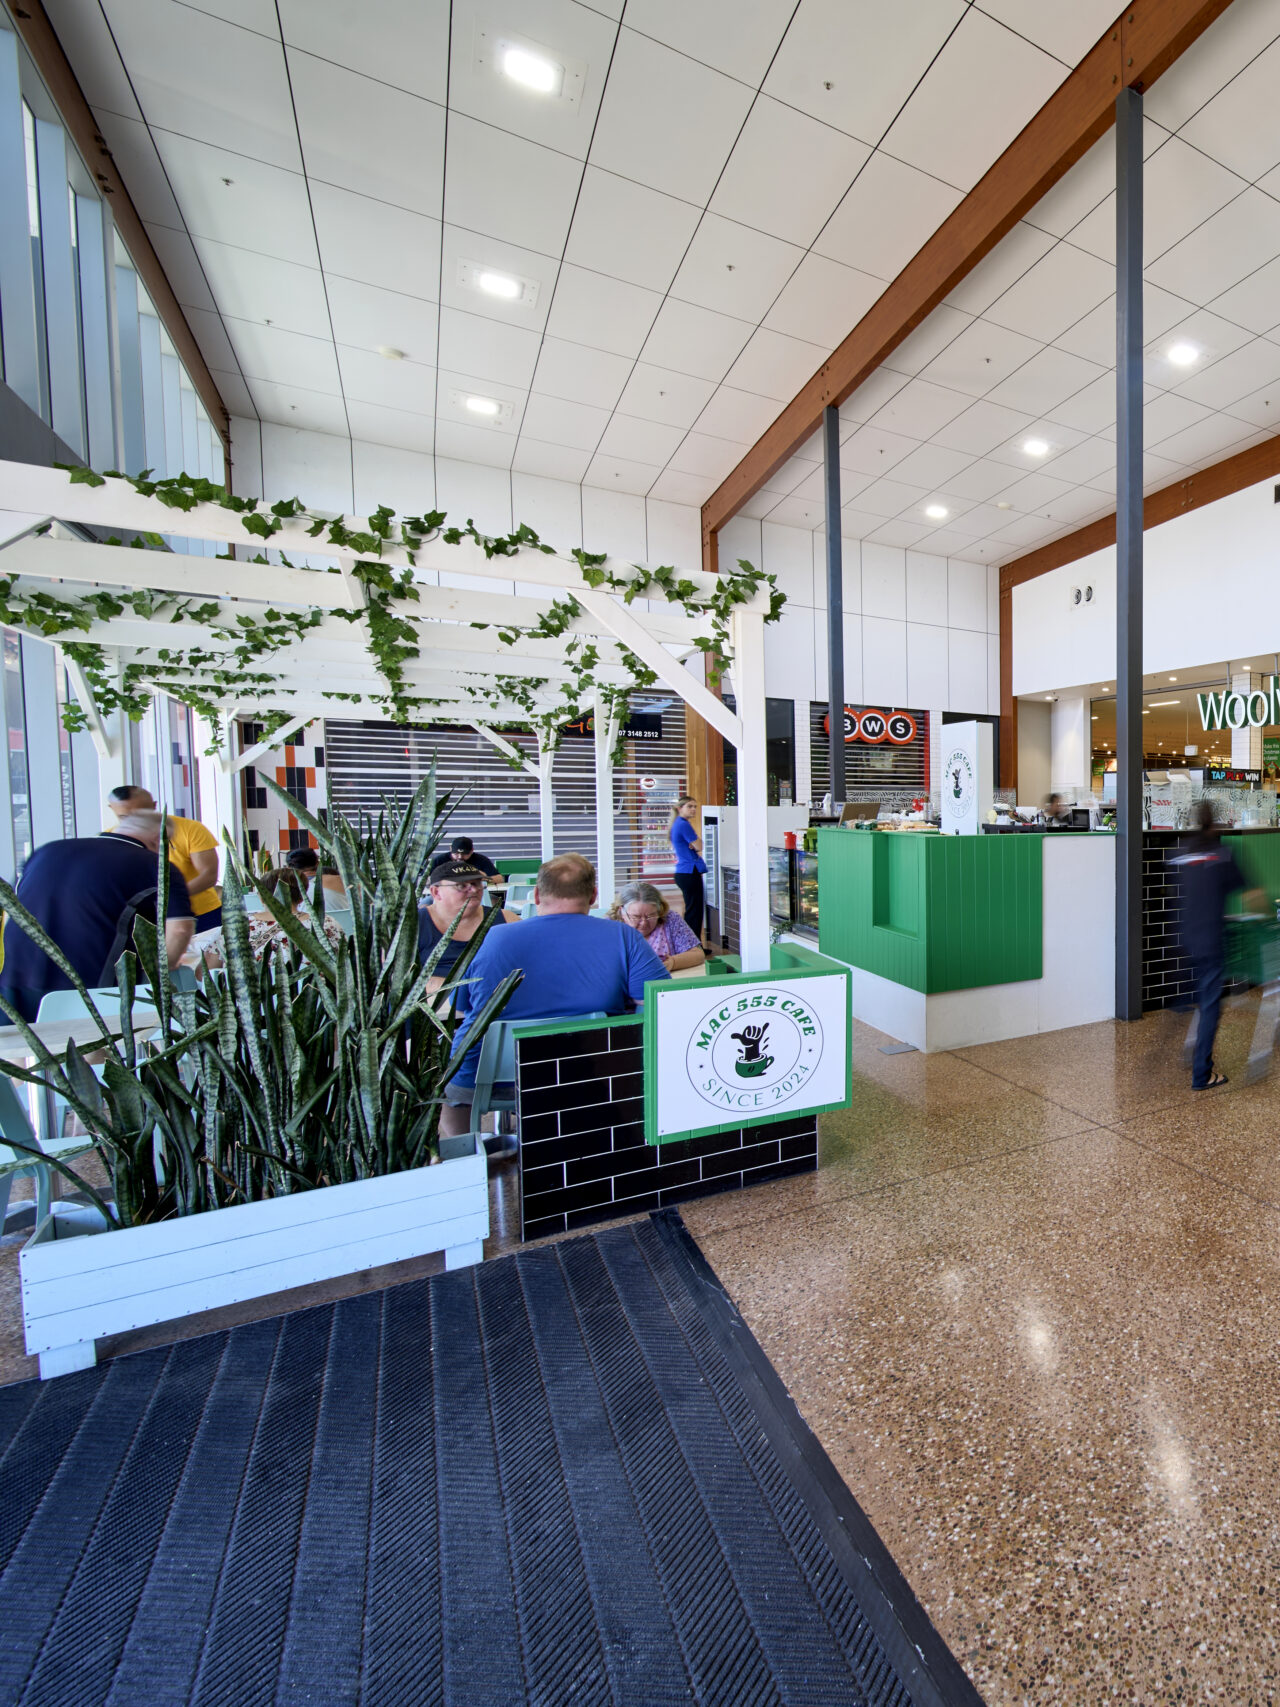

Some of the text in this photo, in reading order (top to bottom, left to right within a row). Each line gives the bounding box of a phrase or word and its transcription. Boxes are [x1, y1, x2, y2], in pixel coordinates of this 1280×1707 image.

[1211, 770, 1226, 780] TAP
[1244, 772, 1260, 781] WIN
[696, 995, 817, 1051] MAC 555 CAFE
[702, 1064, 810, 1107] SINCE 2024
